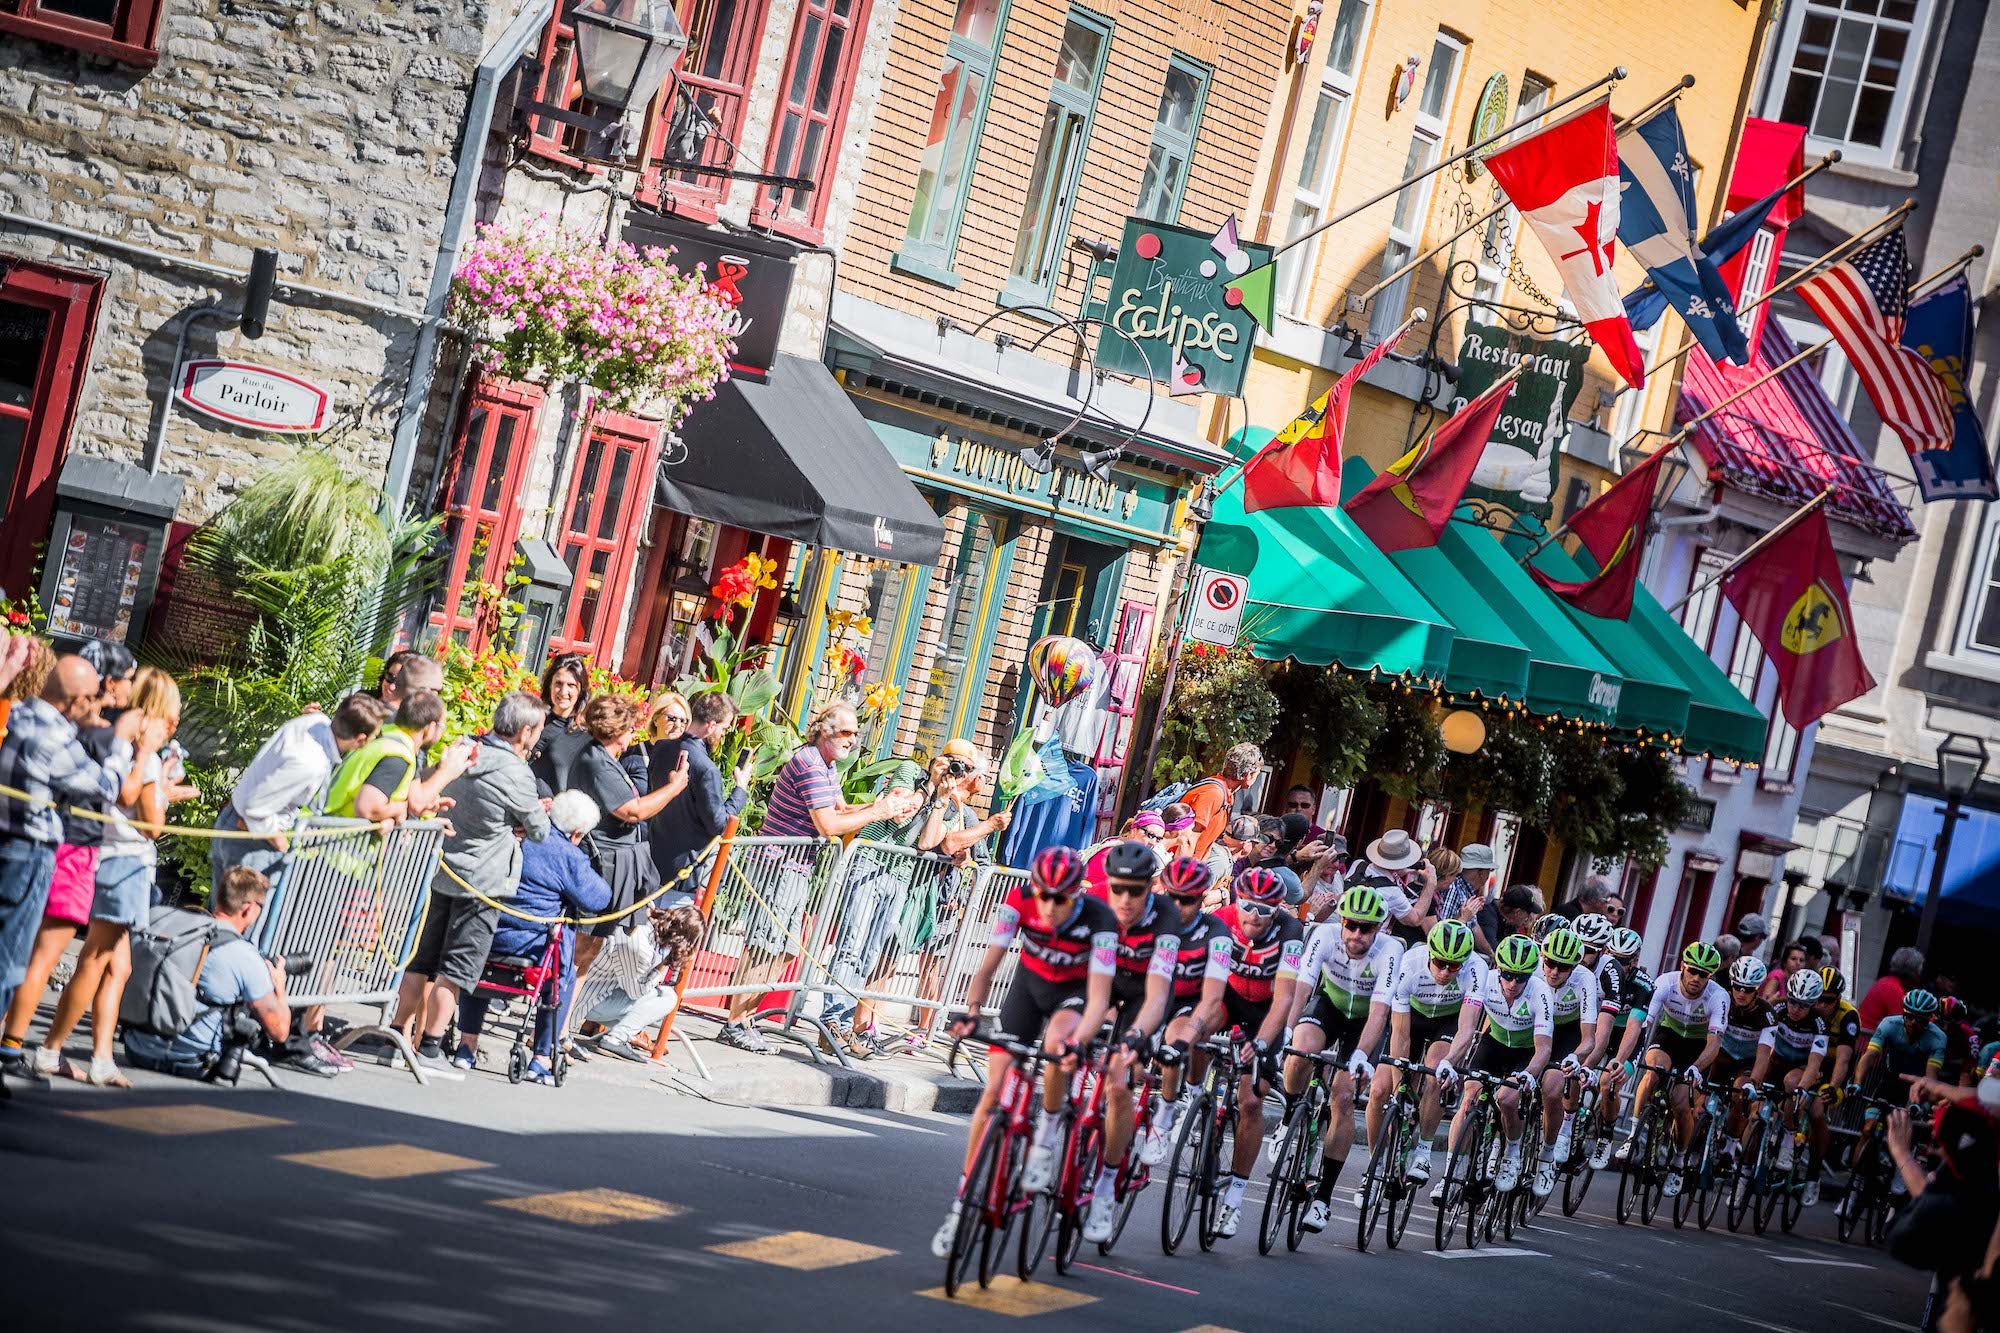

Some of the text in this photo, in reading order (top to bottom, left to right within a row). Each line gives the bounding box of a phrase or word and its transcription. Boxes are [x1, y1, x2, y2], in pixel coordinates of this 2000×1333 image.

[1145, 256, 1218, 313] Boutique
[1112, 281, 1239, 363] Eclipse
[1465, 333, 1571, 381] Restarant
[219, 383, 290, 414] Parloir
[241, 376, 275, 391] Rue du
[1194, 617, 1236, 636] DE CE CÔTÉ
[1607, 967, 1620, 993] GIANT
